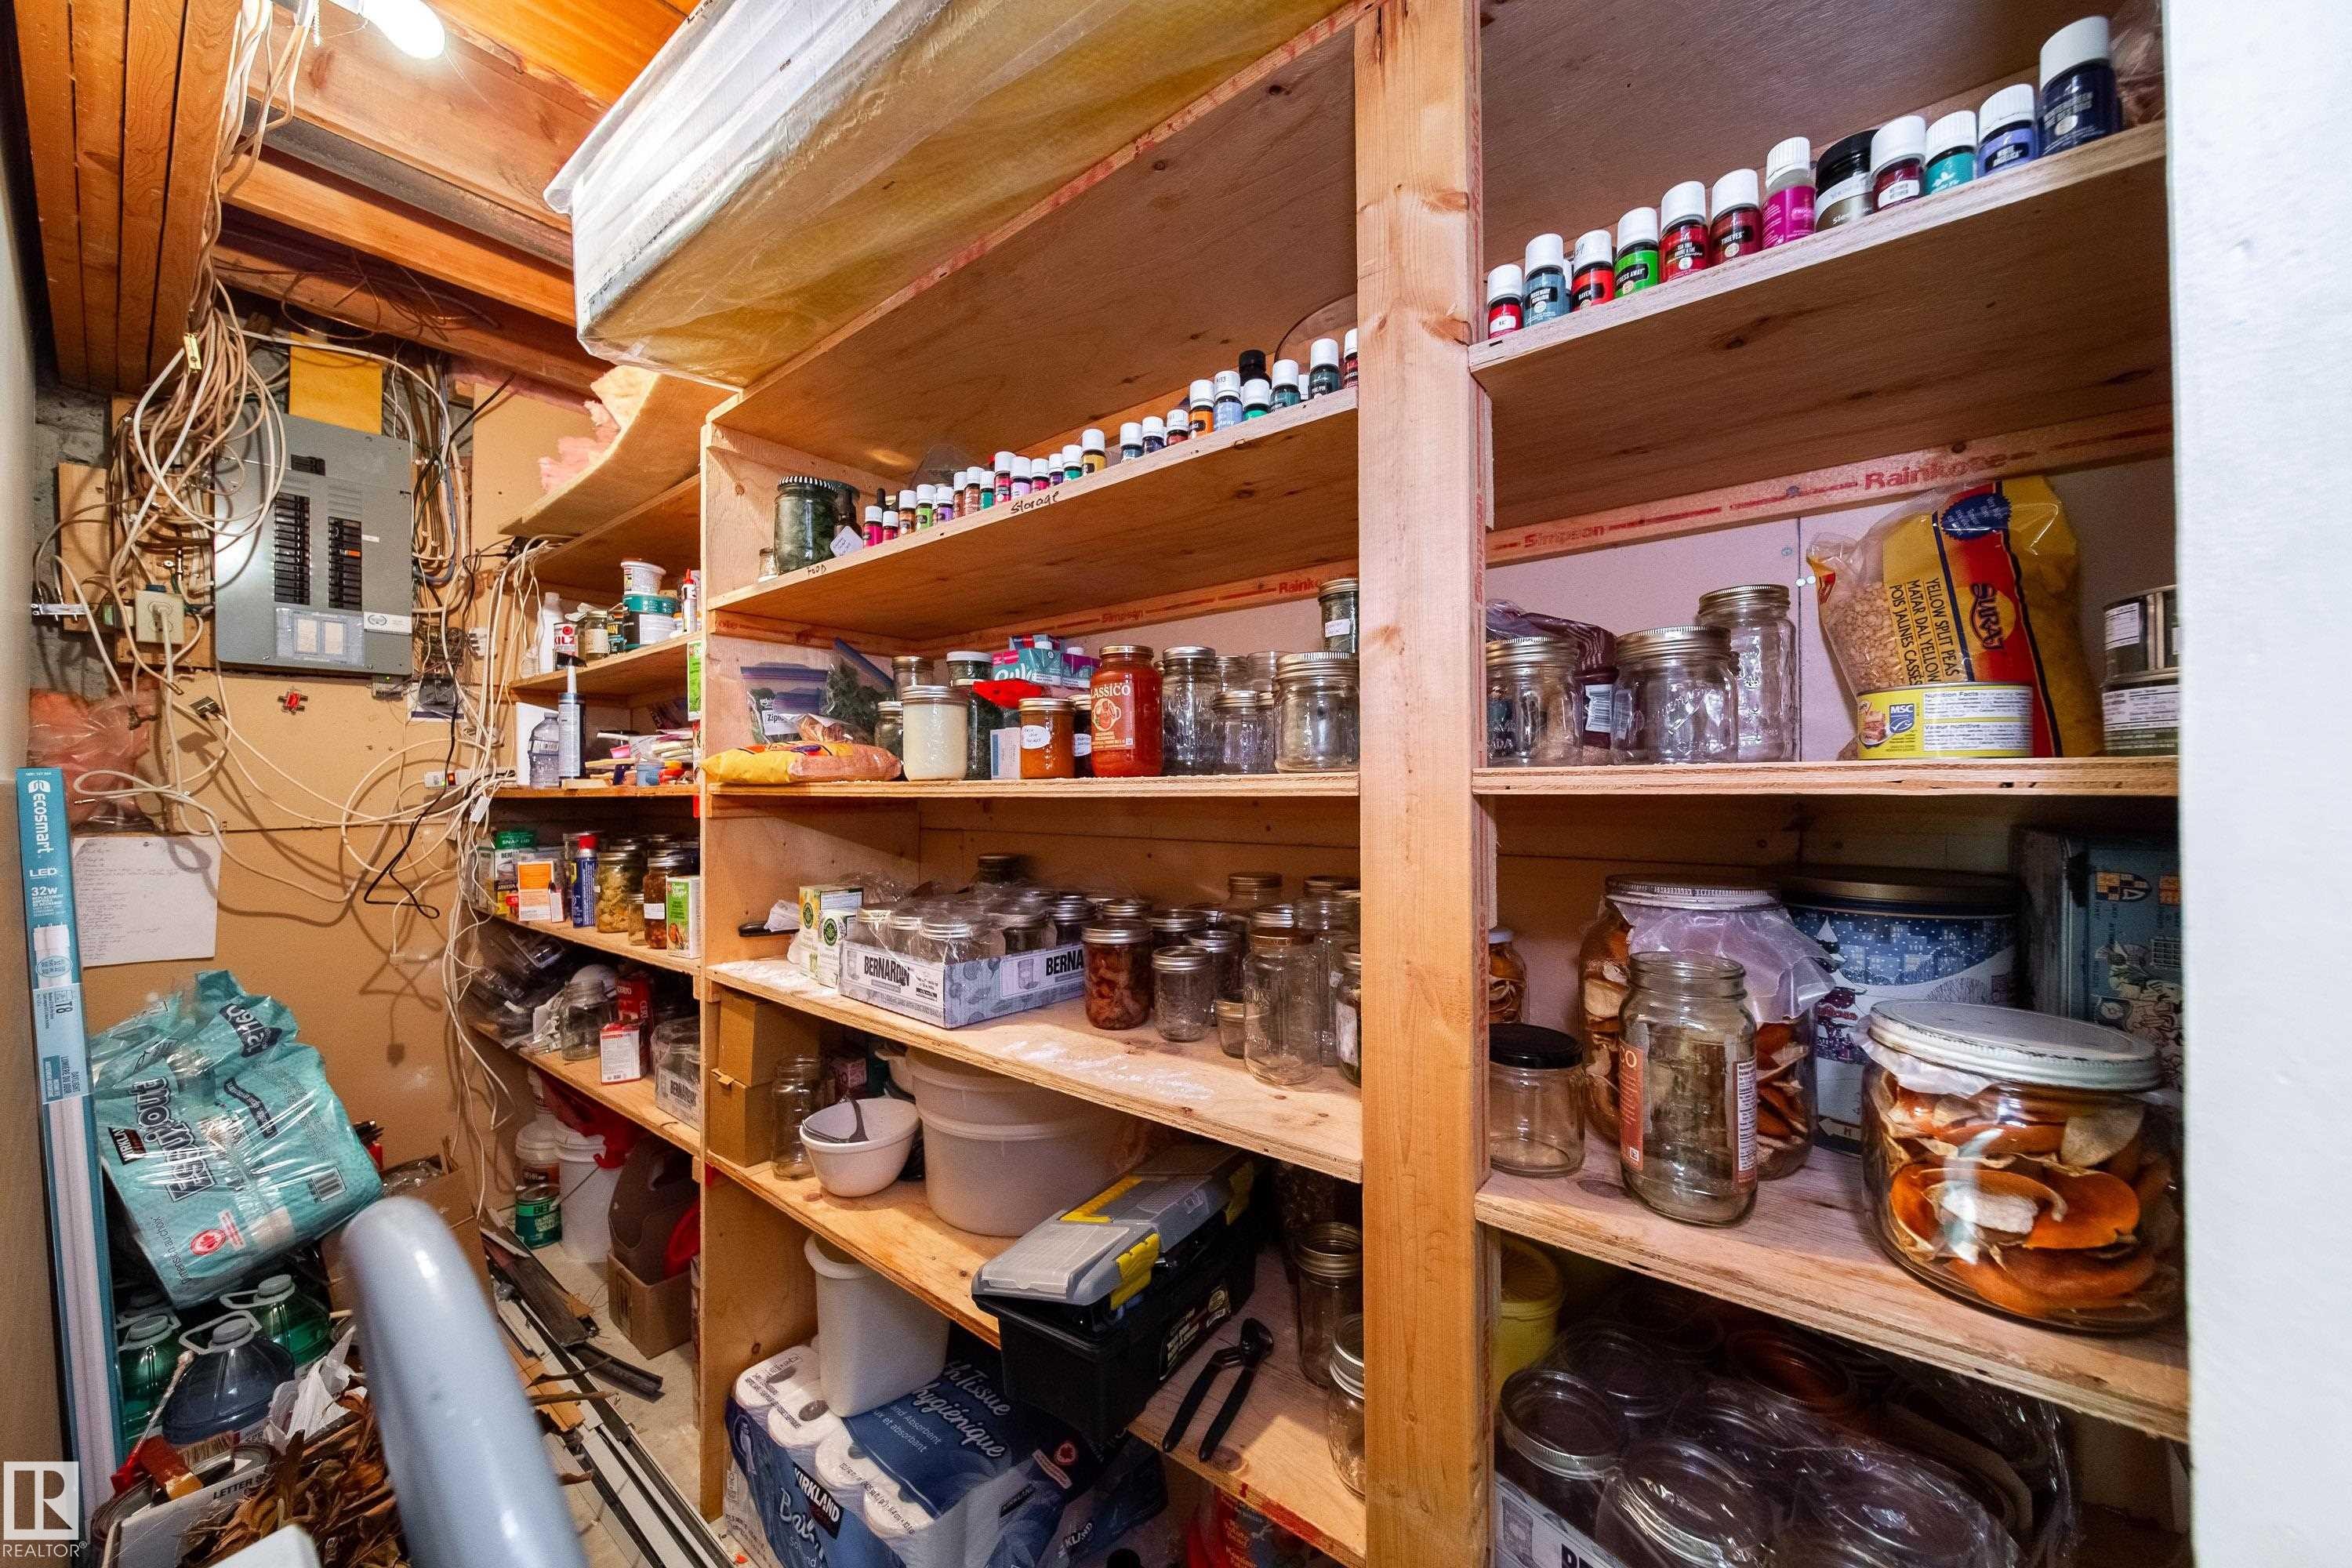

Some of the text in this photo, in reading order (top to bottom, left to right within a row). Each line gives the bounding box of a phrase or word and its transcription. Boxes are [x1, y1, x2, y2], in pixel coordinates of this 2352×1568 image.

[1010, 491, 1059, 514] Storage
[1523, 524, 1606, 549] Simpson
[1889, 584, 1906, 608] POIS
[1893, 608, 1915, 648] JAUNES
[1907, 579, 1943, 682] MATAR DAL YELLOW
[1925, 577, 1960, 677] YELLOW SPLIT PEAS
[1091, 683, 1131, 699] LASSICO
[1890, 704, 1915, 713] MSC
[32, 793, 54, 854] ecosmart
[29, 868, 58, 878] LED
[31, 886, 58, 896] 32w
[863, 955, 910, 987] BERNARDIN
[56, 1000, 73, 1014] T8
[956, 1369, 1012, 1417] Tissue
[882, 1417, 893, 1426] et
[890, 1422, 928, 1453] absorbant
[904, 1414, 942, 1446] Absorbent
[213, 1479, 253, 1500] LETTER
[794, 1467, 840, 1523] KIRKLAND
